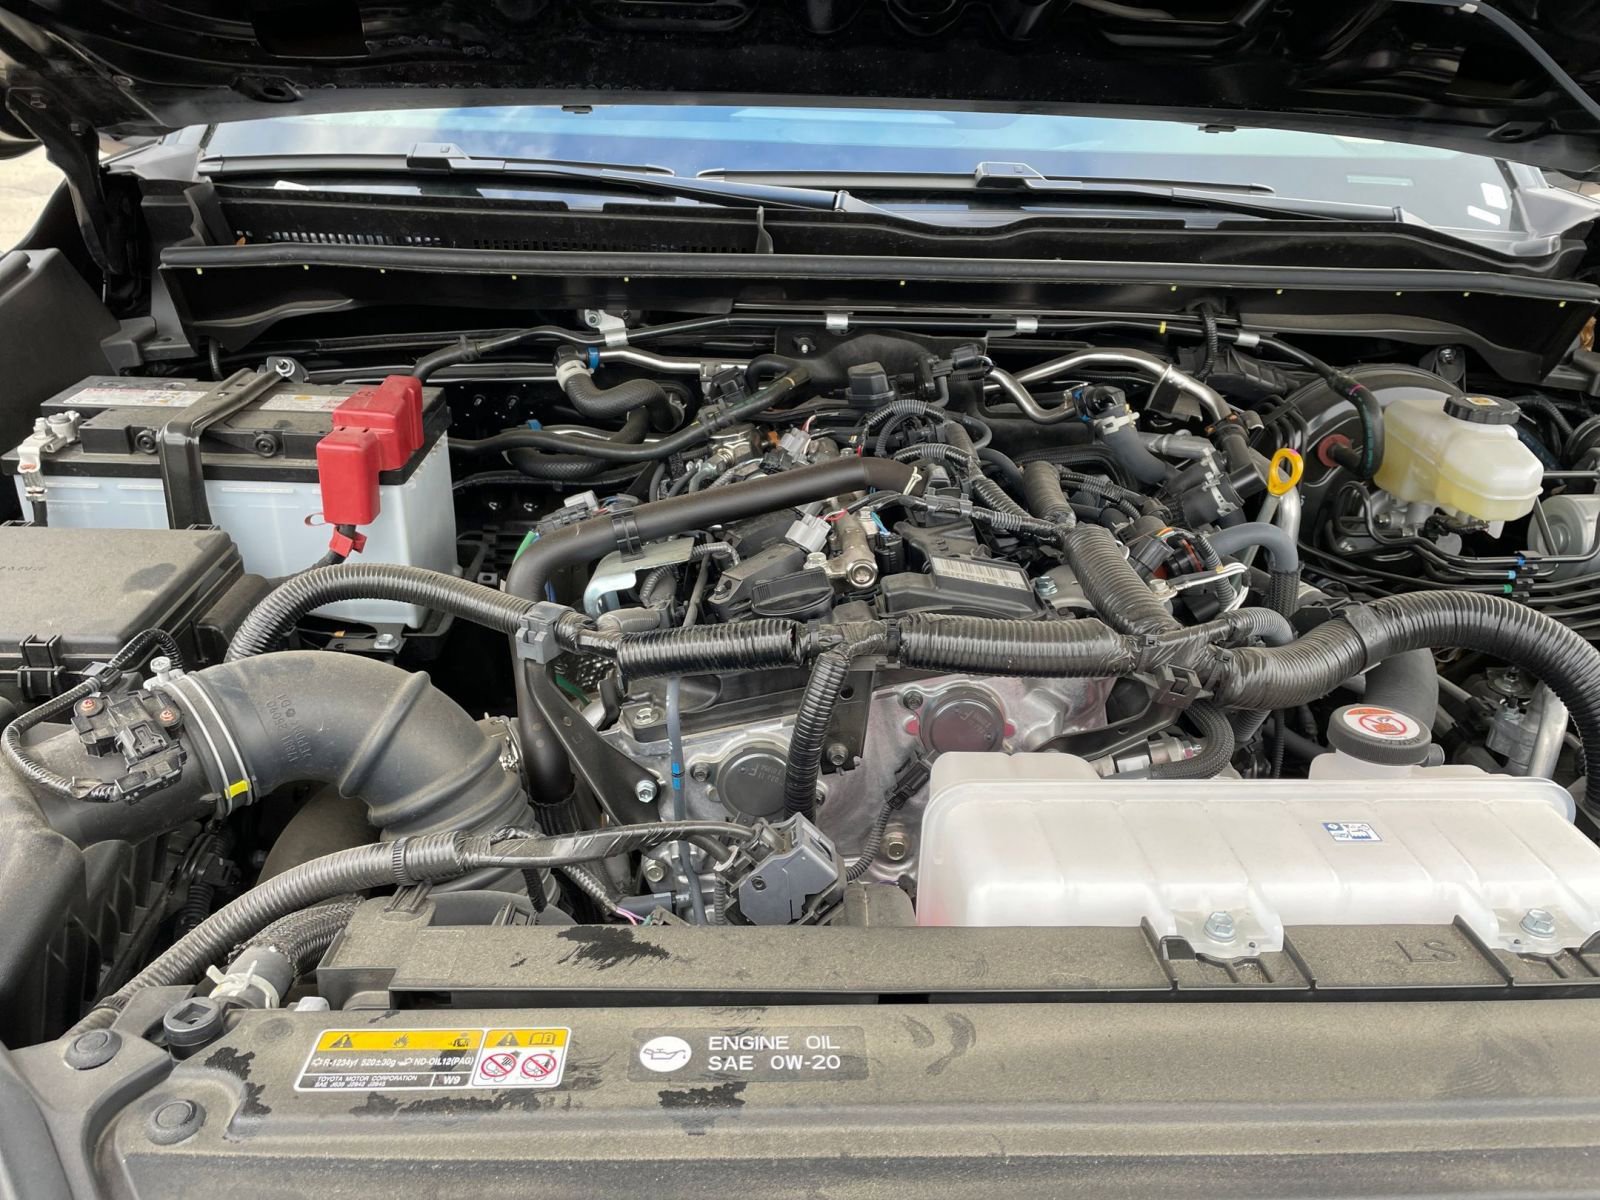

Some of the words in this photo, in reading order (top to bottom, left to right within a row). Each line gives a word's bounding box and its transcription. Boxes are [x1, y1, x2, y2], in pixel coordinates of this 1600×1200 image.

[708, 1035, 790, 1050] ENGINE
[806, 1035, 841, 1050] OIL
[707, 1055, 754, 1071] SAE
[770, 1054, 841, 1070] 0W-20
[371, 1074, 418, 1082] CORPORATION
[443, 1075, 461, 1085] W9
